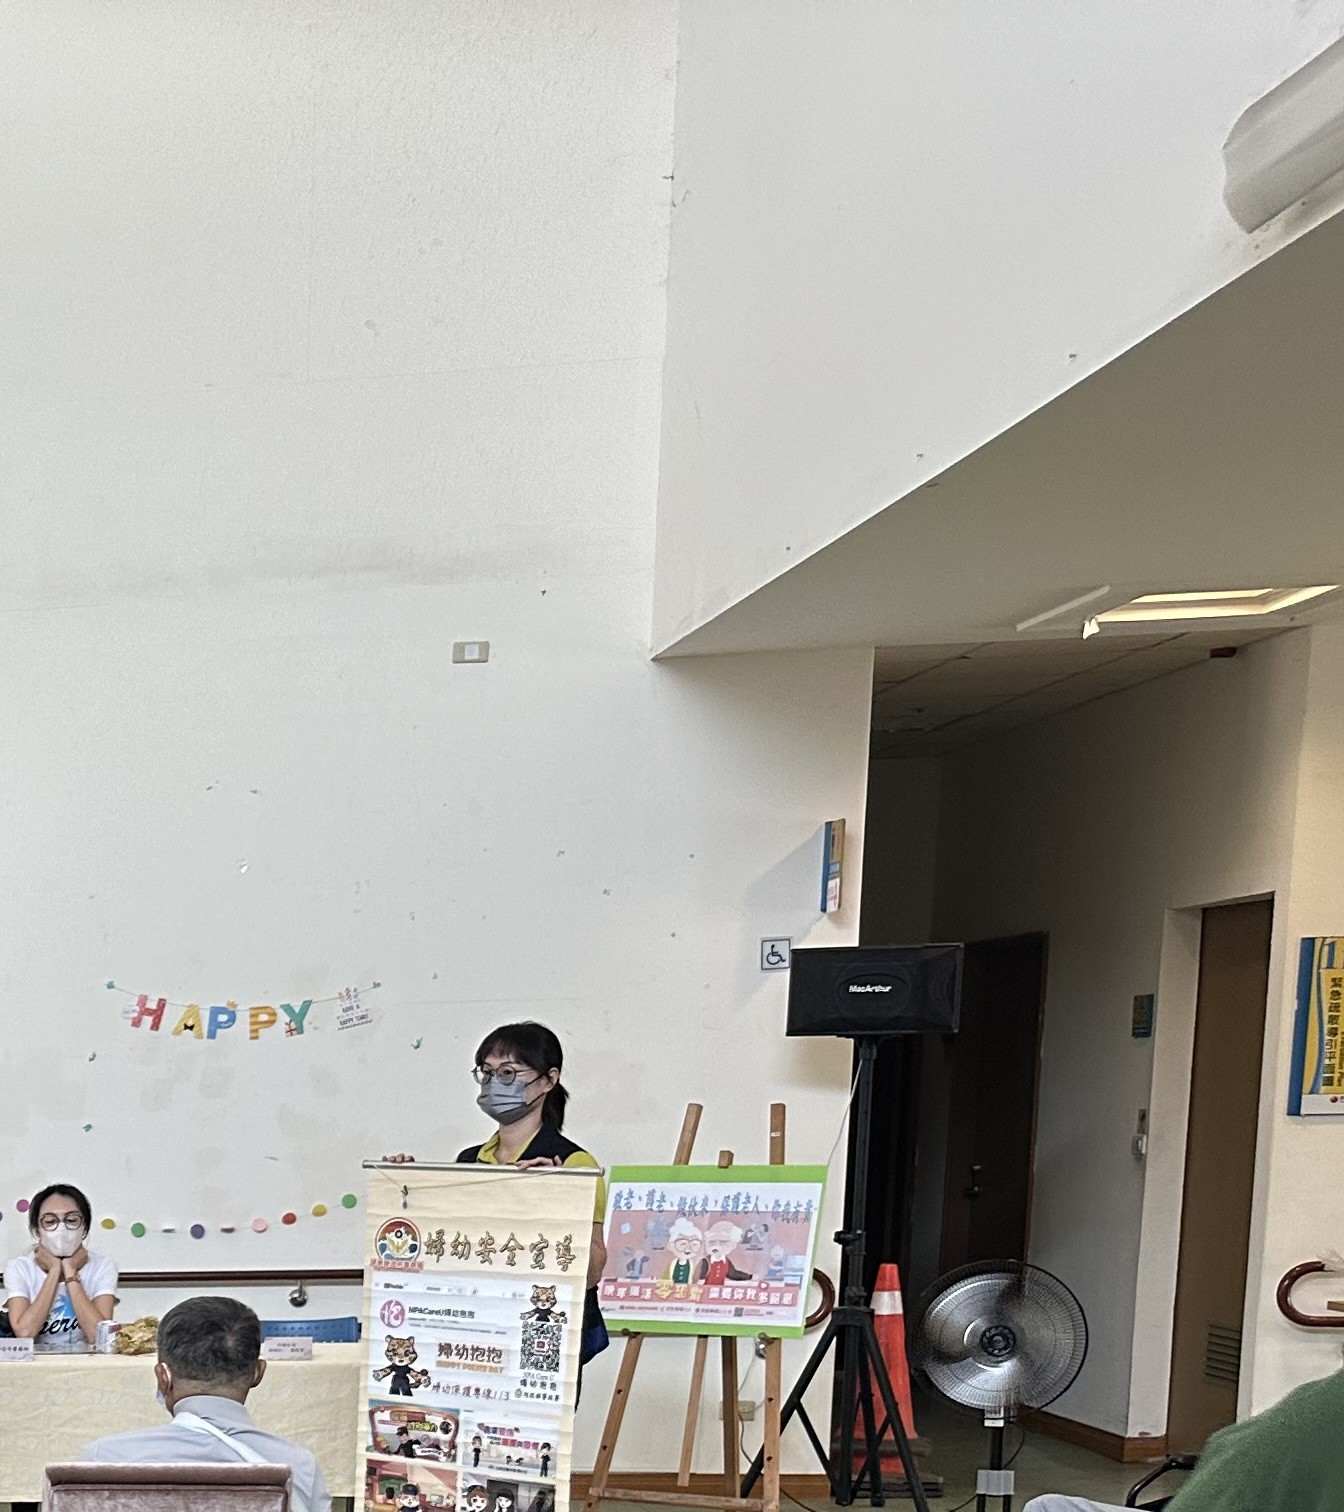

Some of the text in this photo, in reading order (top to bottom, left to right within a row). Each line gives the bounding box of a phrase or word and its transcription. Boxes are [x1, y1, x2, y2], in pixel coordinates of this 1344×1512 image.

[131, 994, 312, 1041] HAPPY
[423, 1229, 576, 1272] 婦幼安全宣導
[437, 1342, 503, 1364] 婦幼抱抱
